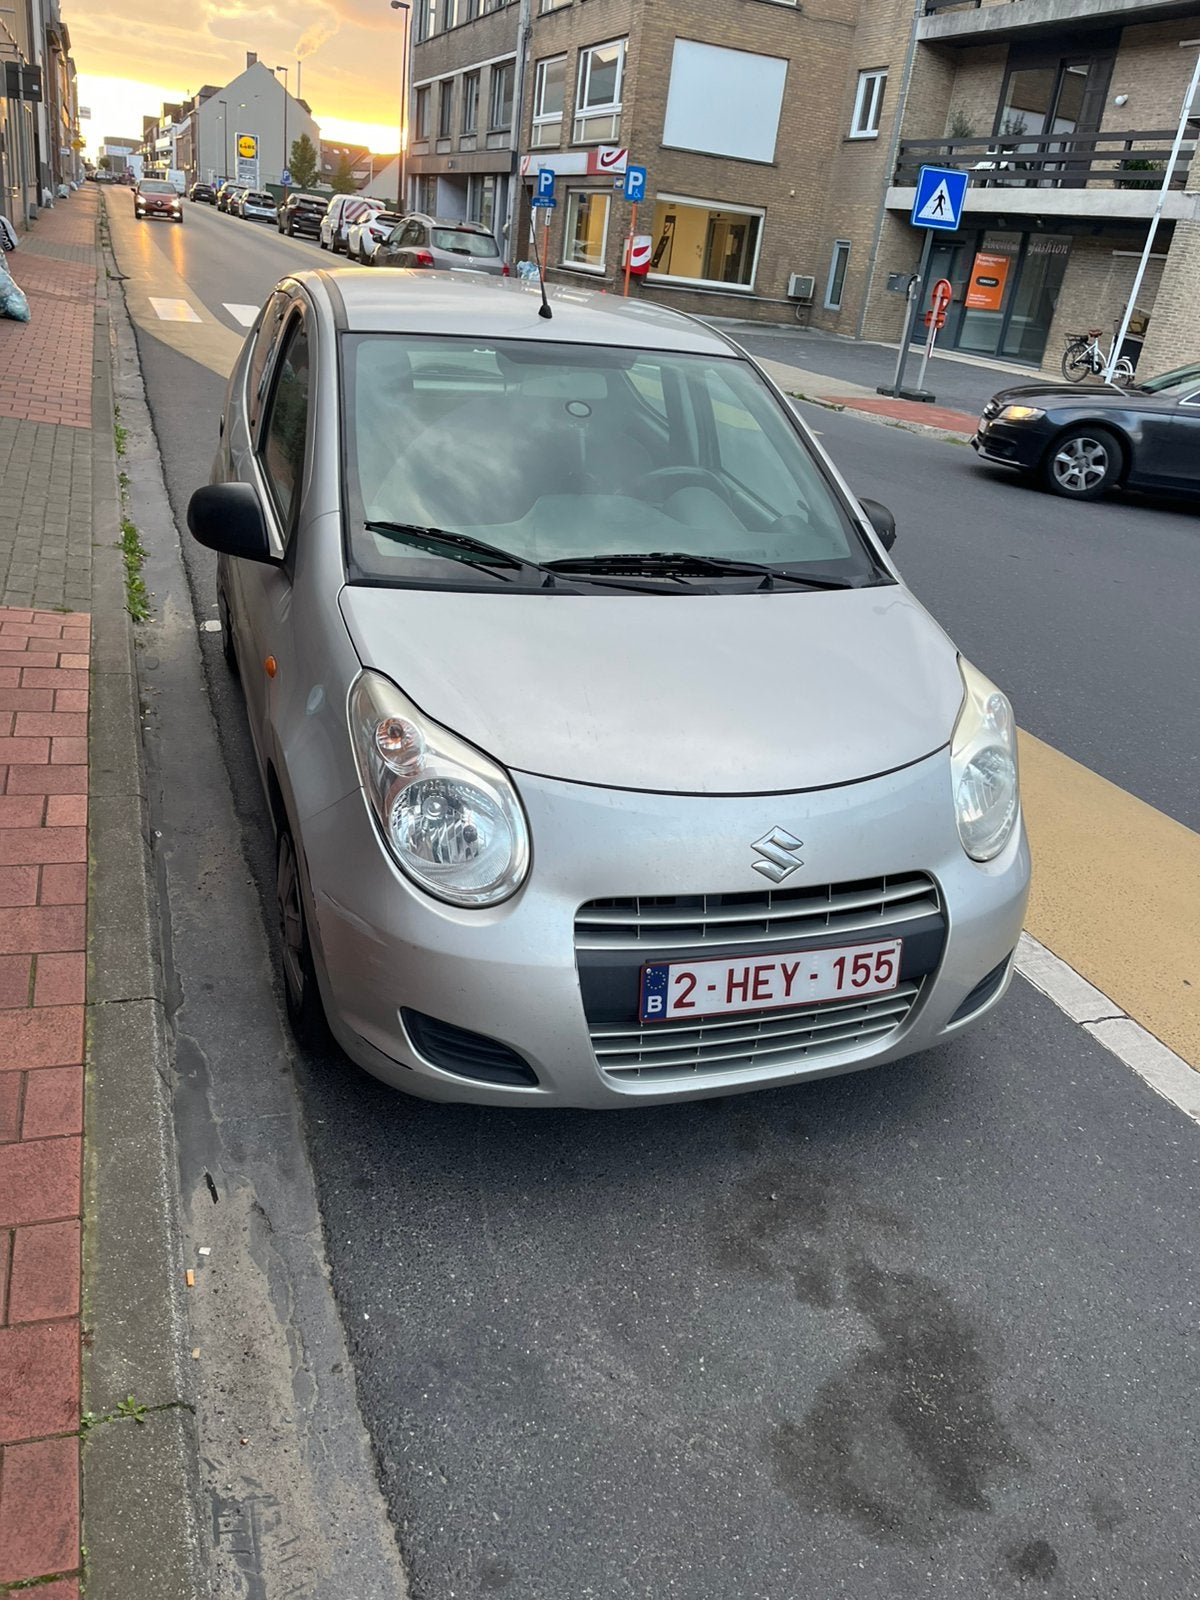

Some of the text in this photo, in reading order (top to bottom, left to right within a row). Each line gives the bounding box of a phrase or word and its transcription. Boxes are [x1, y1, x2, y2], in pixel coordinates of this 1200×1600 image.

[540, 172, 553, 192] P
[627, 171, 643, 195] P
[647, 995, 662, 1013] B
